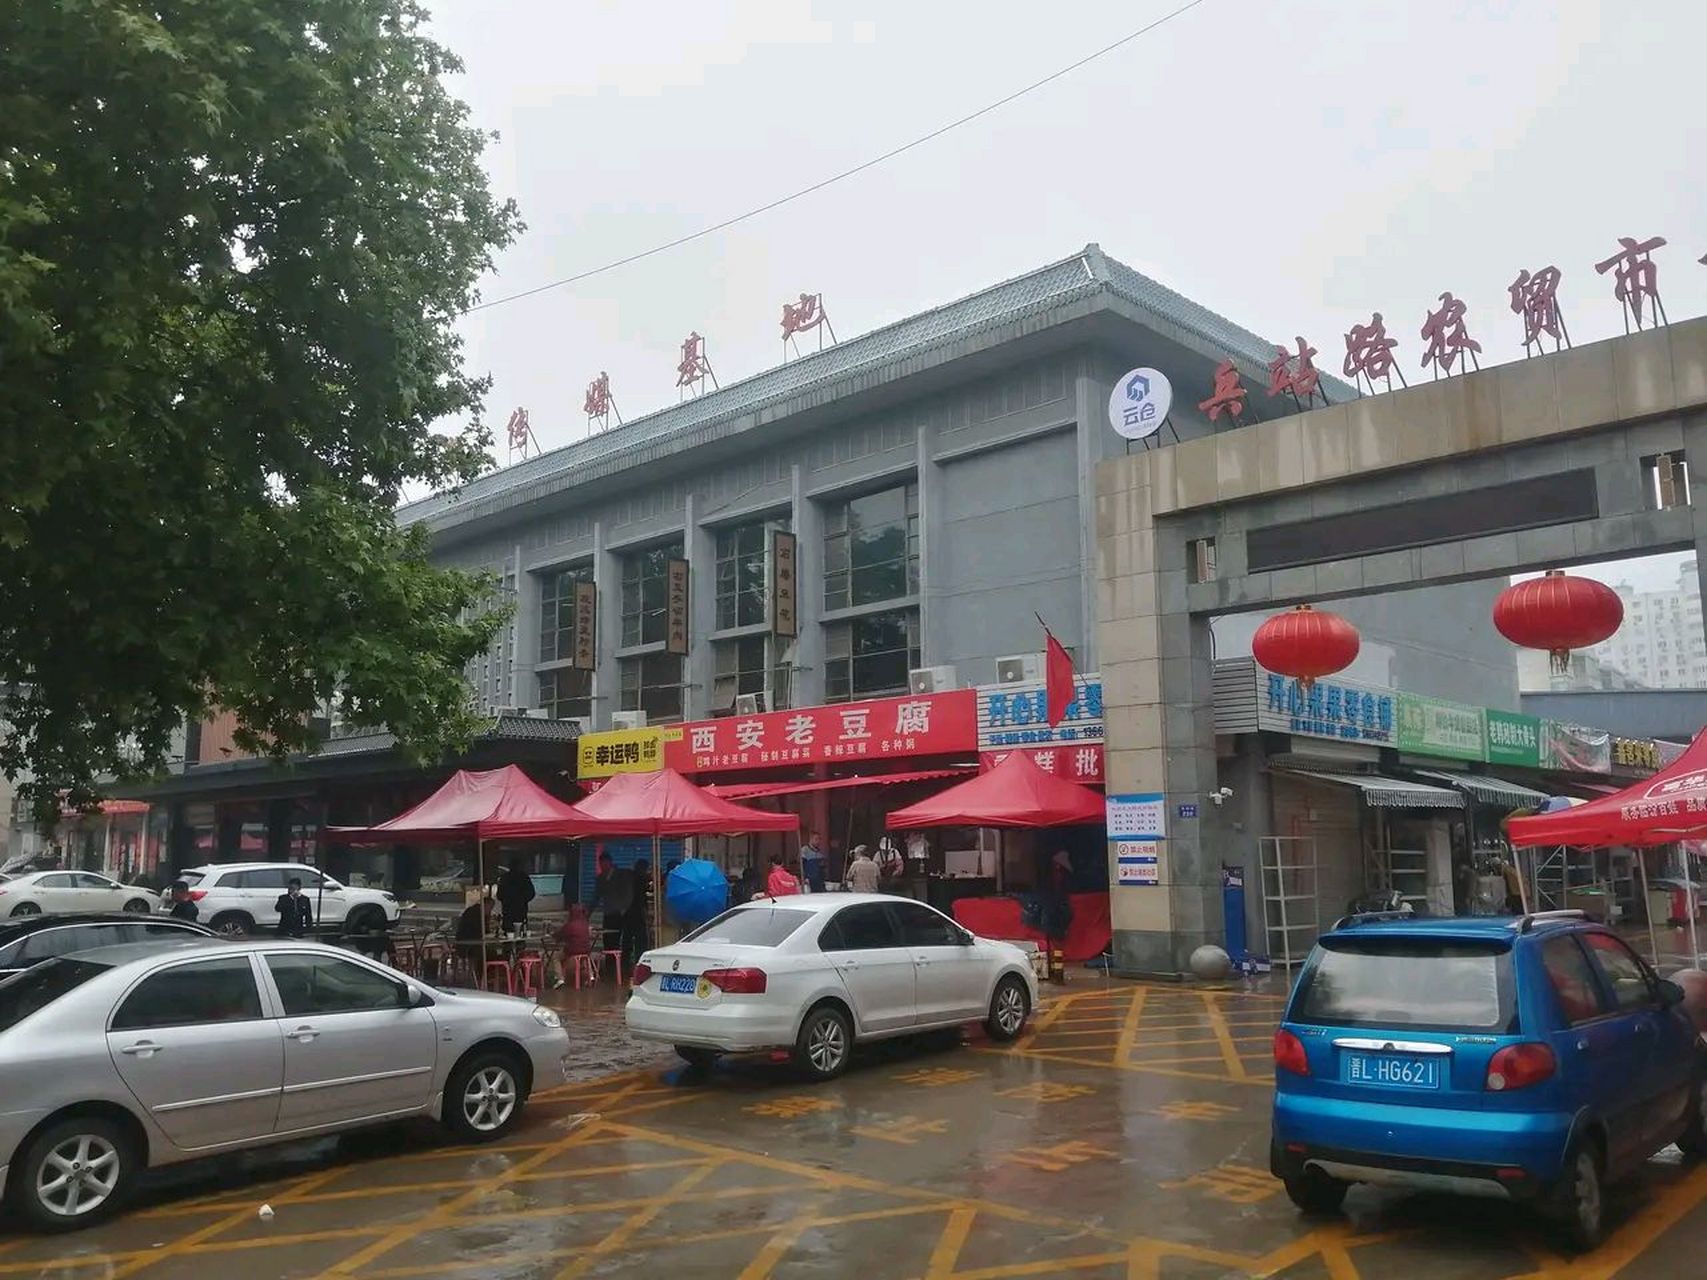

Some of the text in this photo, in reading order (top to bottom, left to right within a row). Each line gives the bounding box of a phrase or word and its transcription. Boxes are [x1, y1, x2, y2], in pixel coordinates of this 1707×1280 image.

[1199, 236, 1707, 423] 兵站路农贸市
[1122, 402, 1157, 427] 云仓
[690, 700, 932, 755] 西安老豆腐
[595, 741, 640, 767] 幸运鸭
